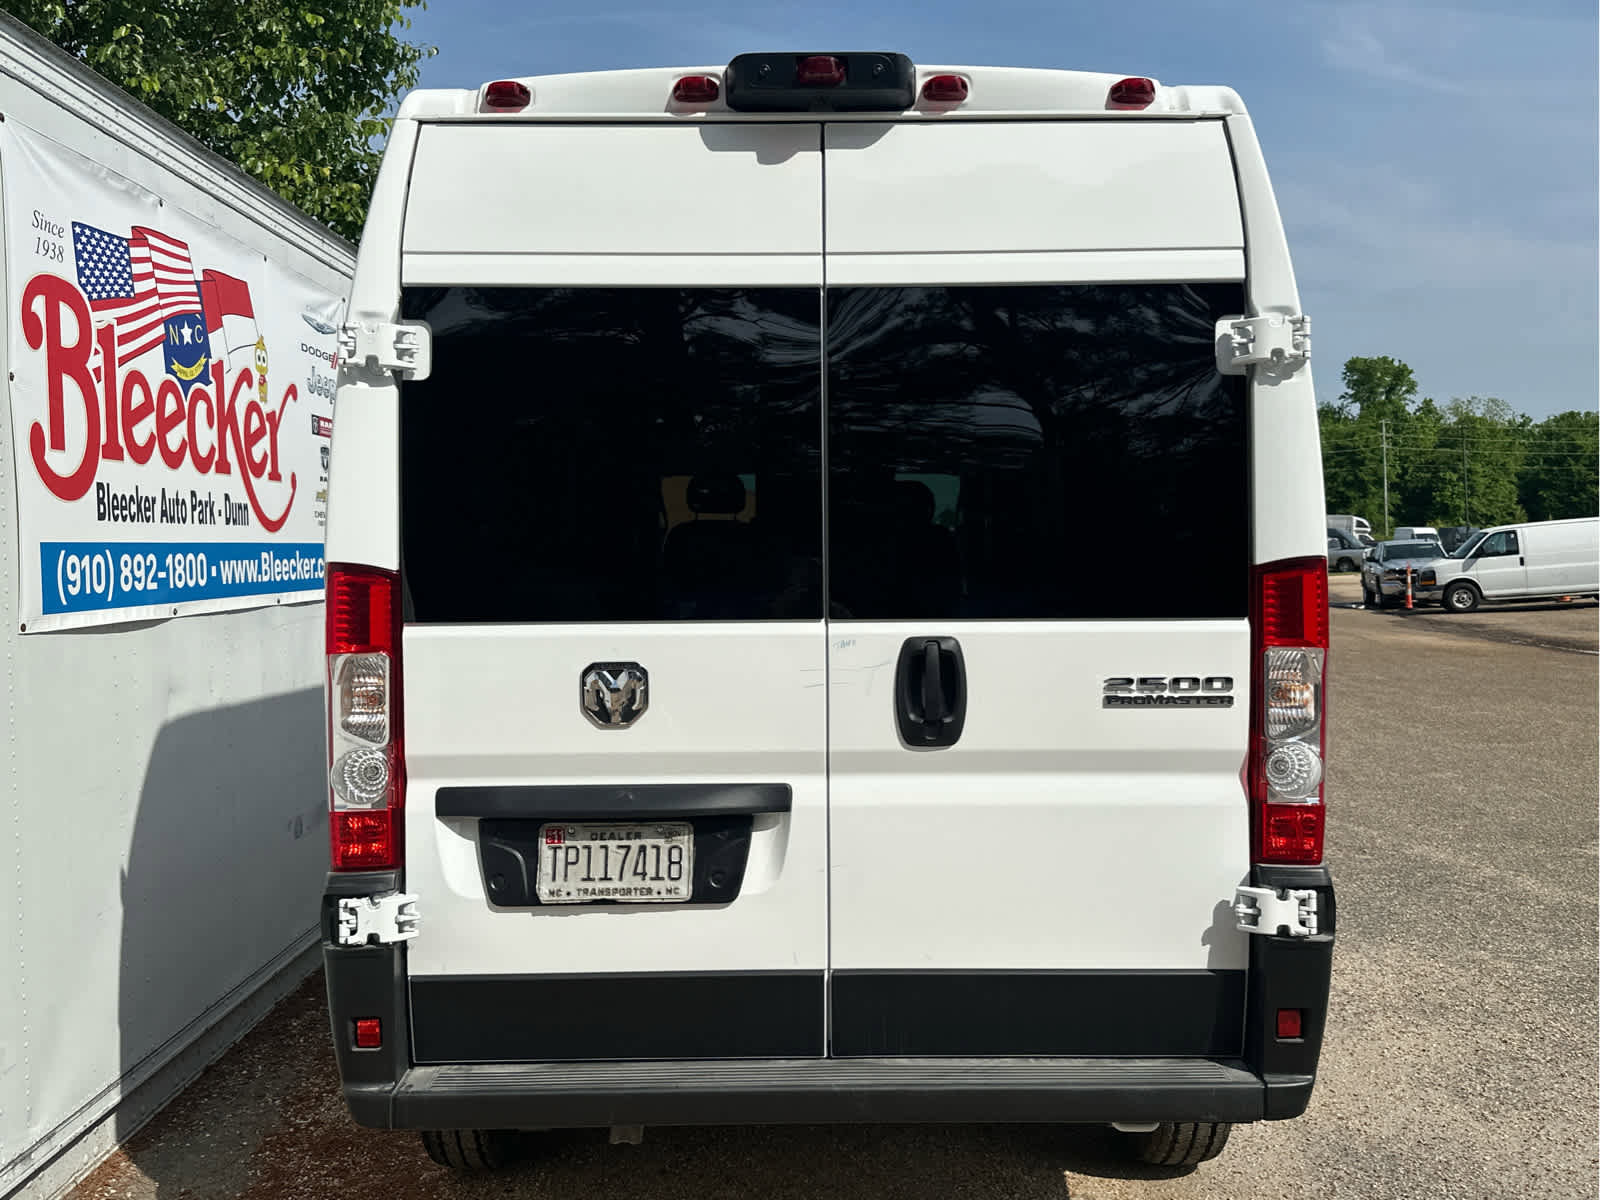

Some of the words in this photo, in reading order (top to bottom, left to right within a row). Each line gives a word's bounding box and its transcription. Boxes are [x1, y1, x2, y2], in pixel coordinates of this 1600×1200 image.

[31, 209, 65, 239] Since
[35, 237, 65, 264] 1938
[168, 323, 180, 347] N
[194, 324, 204, 344] C
[301, 343, 336, 363] DODGE
[306, 365, 336, 405] Jeep
[22, 273, 298, 533] Bleecker
[96, 481, 156, 524] Bleecker
[160, 487, 187, 525] Auto
[191, 491, 216, 526] Park
[224, 493, 249, 526] Dunn
[57, 549, 115, 605] (910)
[120, 553, 207, 591] 892-1800
[1103, 676, 1234, 694] 2500
[590, 831, 642, 841] DEALER
[547, 845, 683, 882] TP117418
[548, 888, 563, 898] NC
[576, 887, 653, 897] TRANSPORTER
[666, 887, 681, 896] NC
